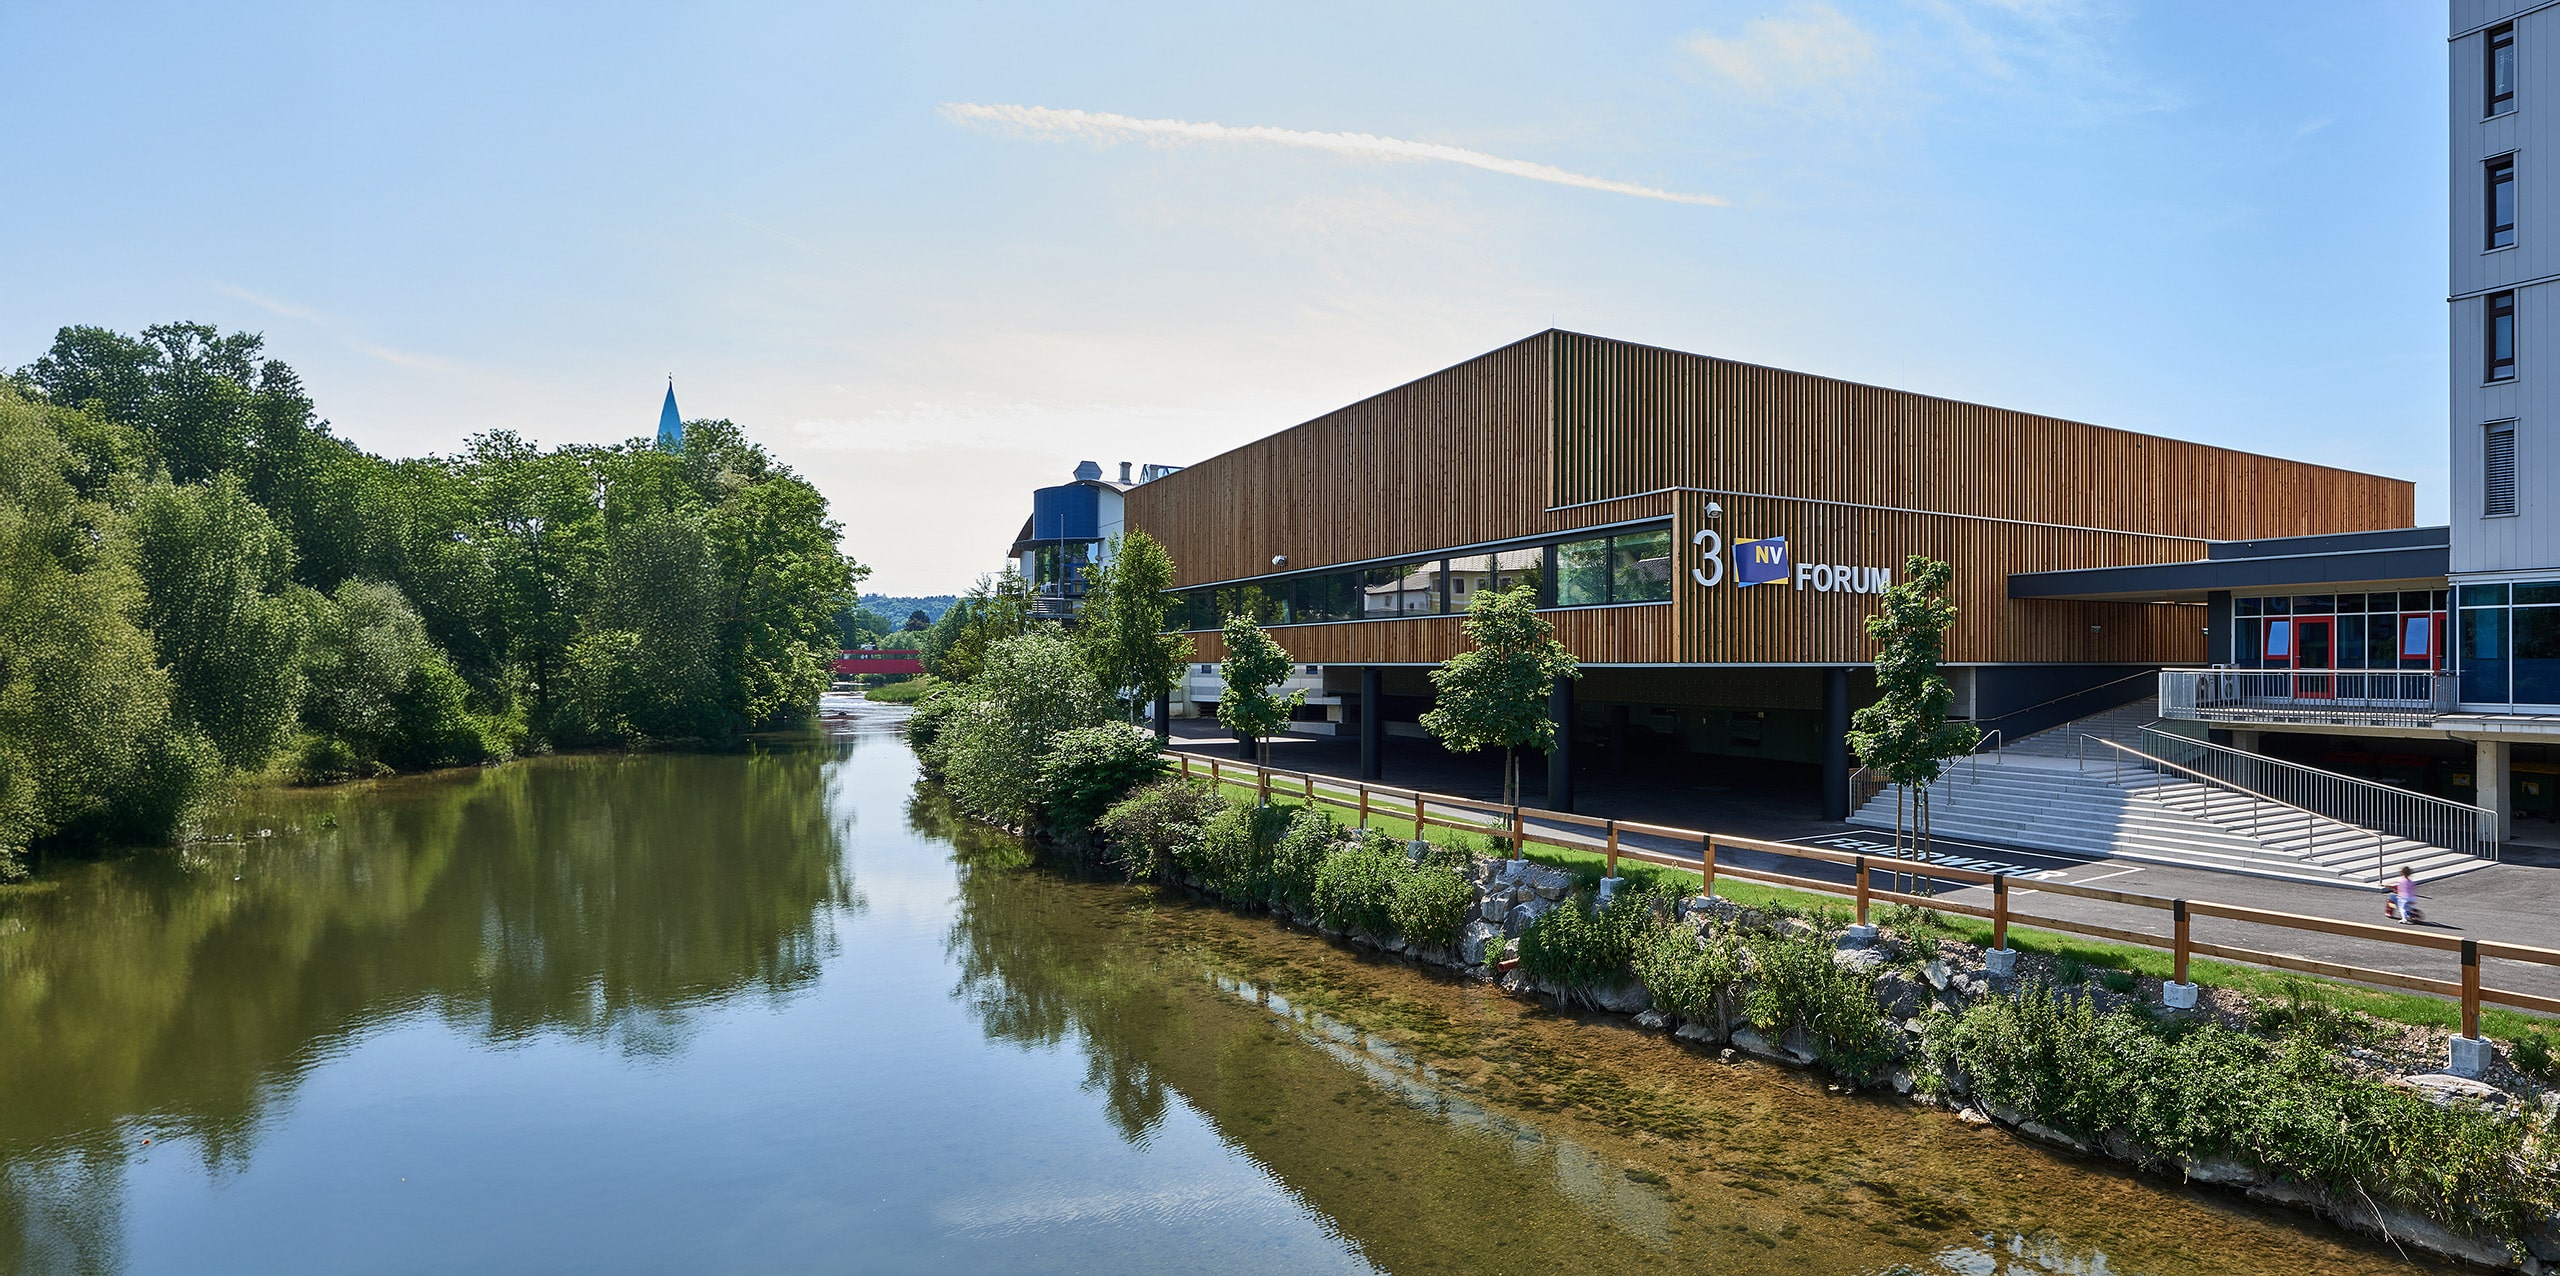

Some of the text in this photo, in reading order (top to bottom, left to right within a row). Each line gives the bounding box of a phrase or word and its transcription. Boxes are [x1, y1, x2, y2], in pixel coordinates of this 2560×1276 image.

[1692, 529, 1891, 594] 3 NV FORUM
